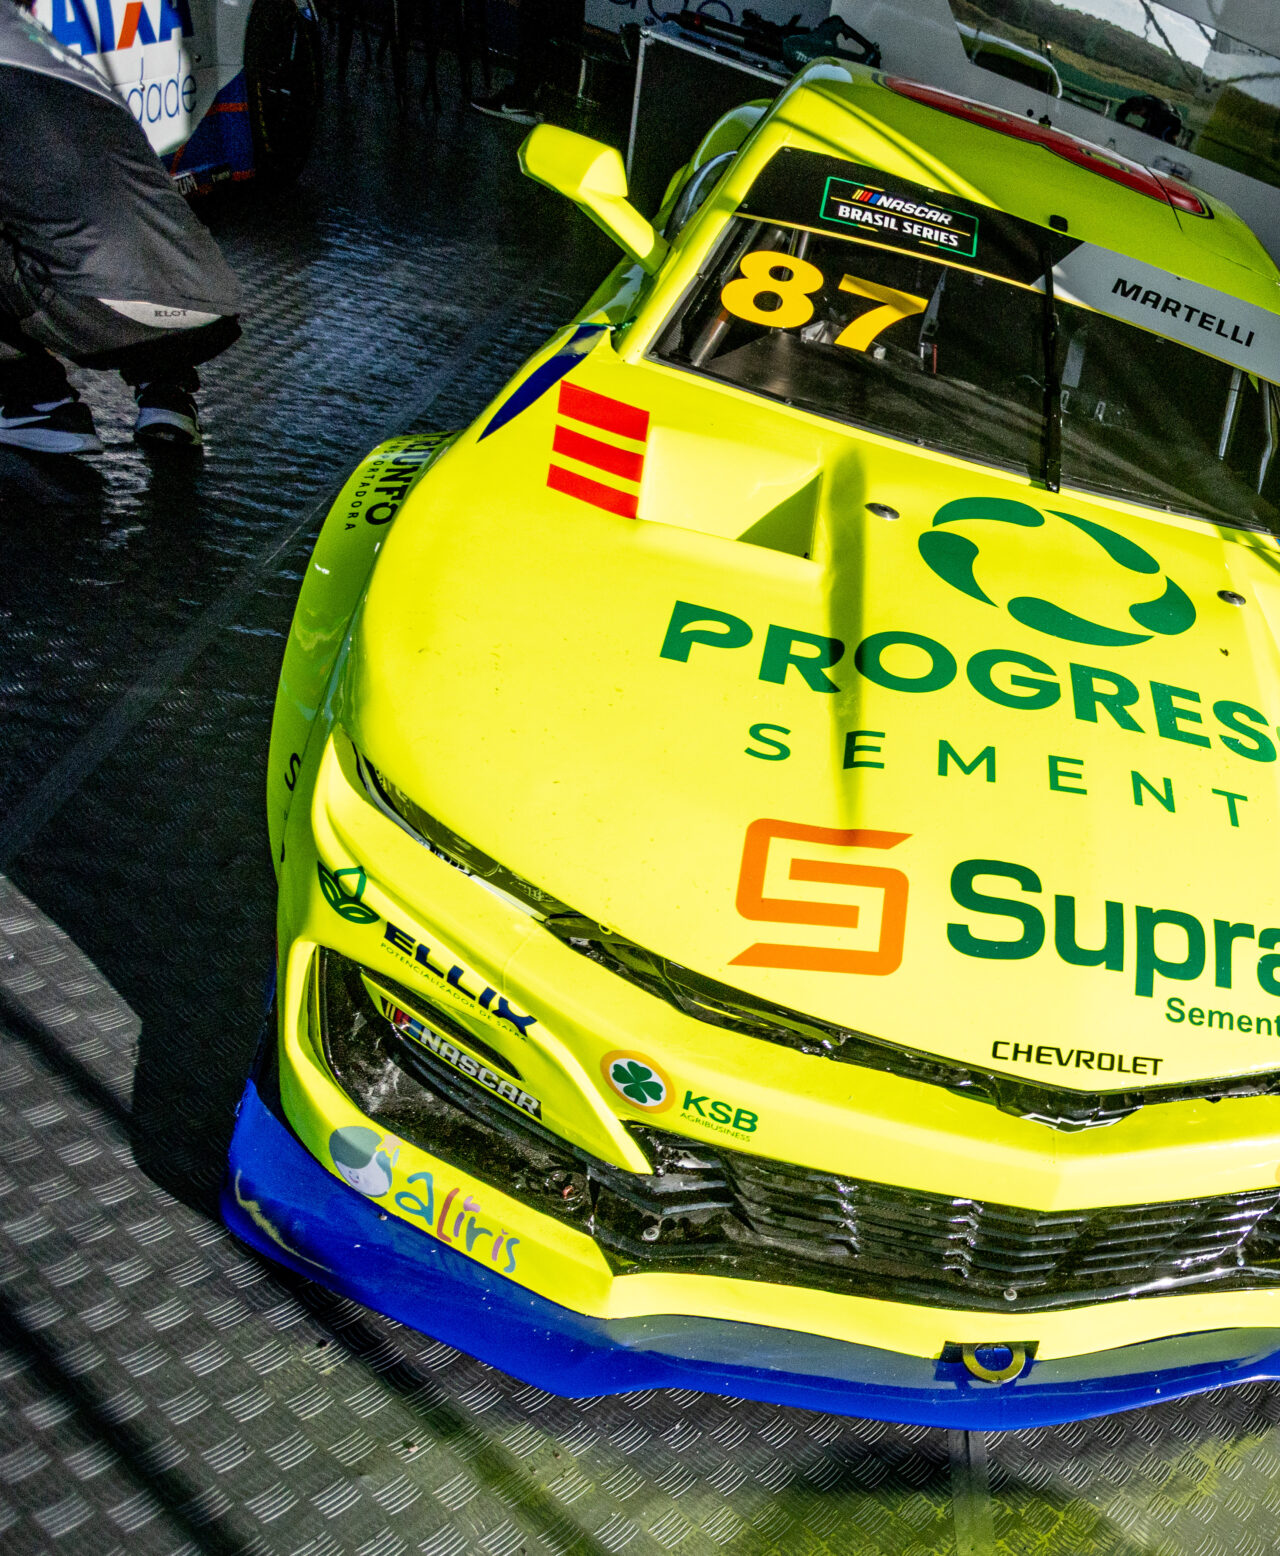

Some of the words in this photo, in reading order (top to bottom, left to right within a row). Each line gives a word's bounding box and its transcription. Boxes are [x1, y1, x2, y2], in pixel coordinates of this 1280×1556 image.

[838, 204, 899, 231] BRASIL
[902, 221, 959, 247] SERIES
[876, 195, 953, 225] NASCAR
[721, 250, 928, 351] 87
[1111, 277, 1255, 349] MARTELLI
[385, 921, 538, 1038] ELLIX
[421, 1027, 539, 1115] NASCAR
[991, 1040, 1164, 1076] CHEVROLET
[680, 1113, 751, 1143] AGRIBUSINESS
[683, 1090, 759, 1133] KSB
